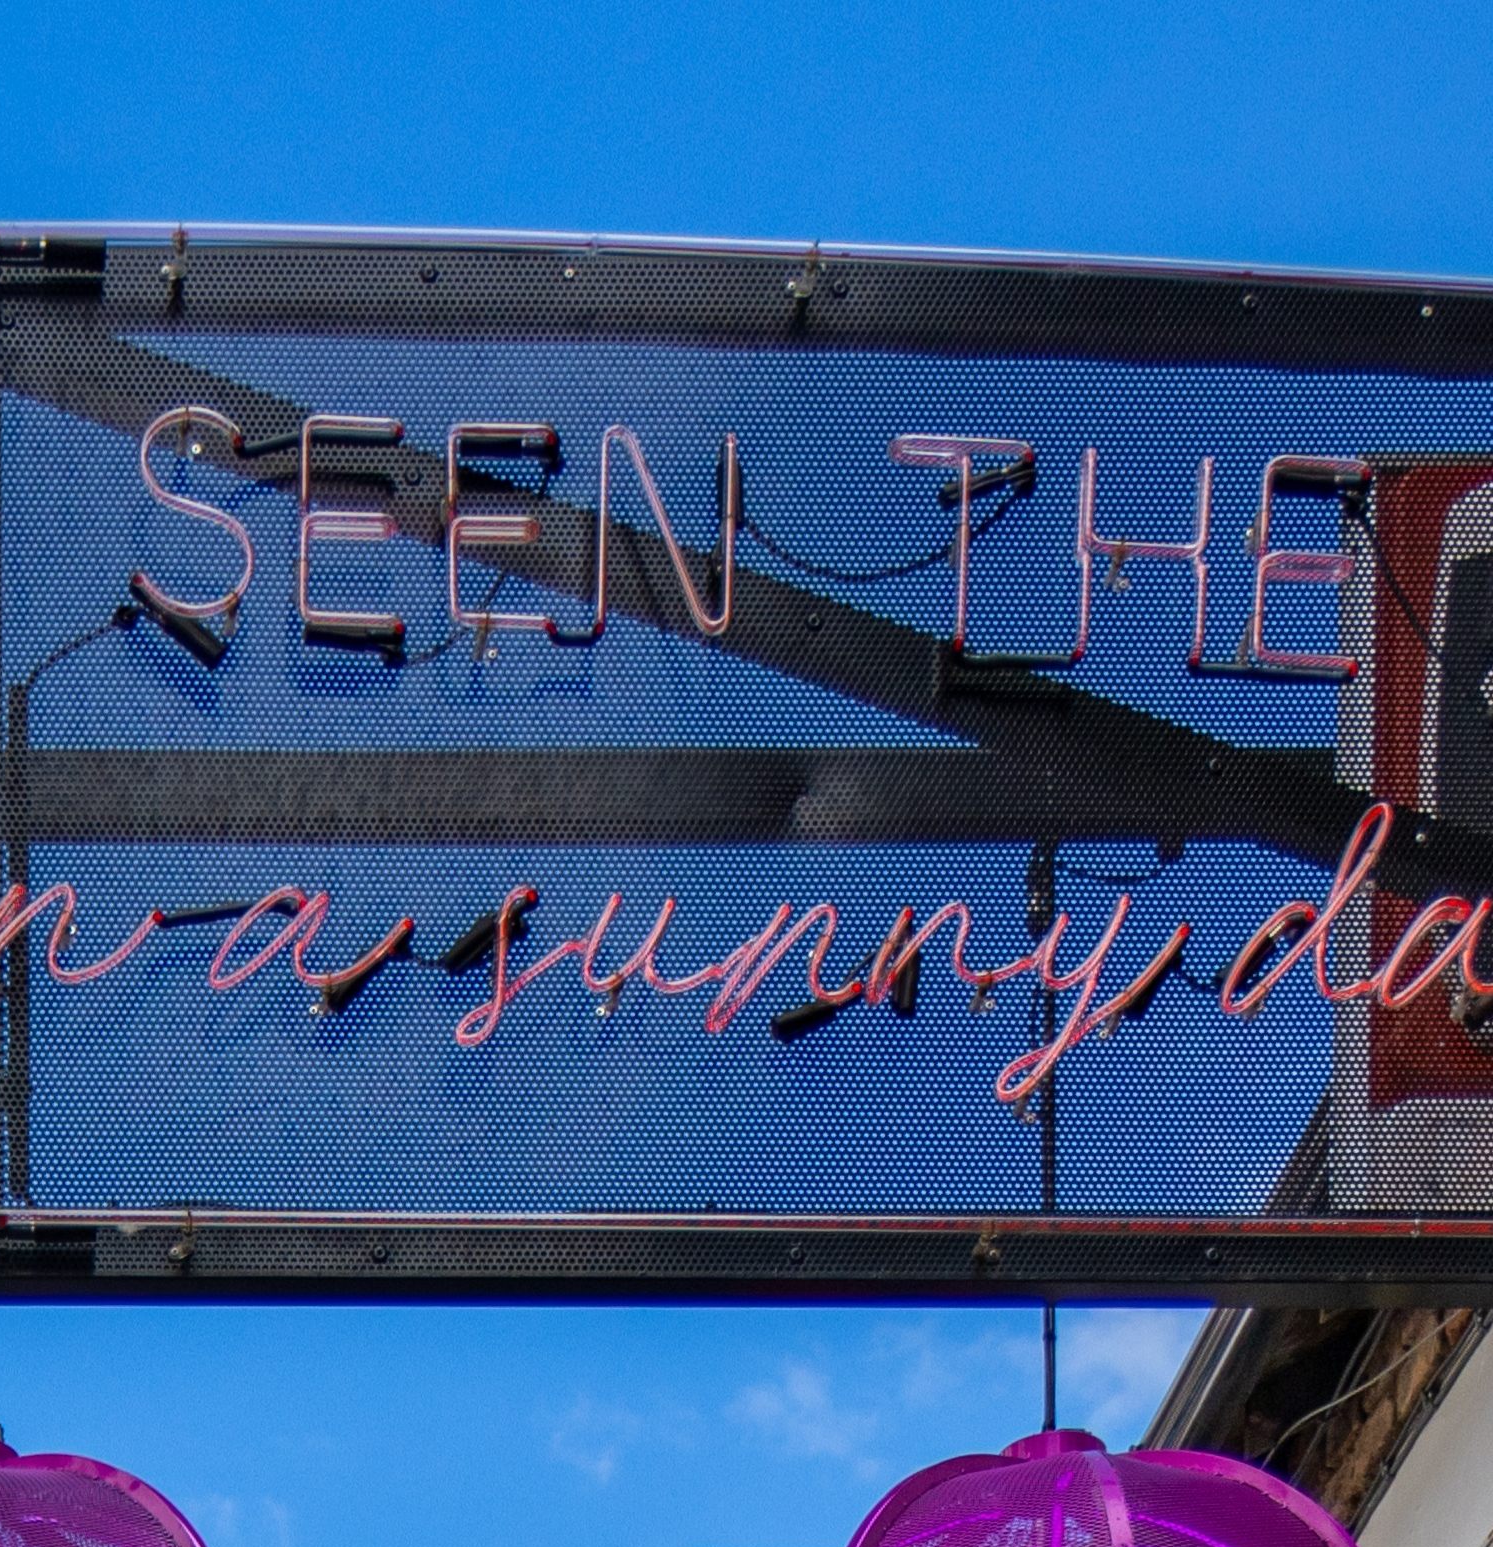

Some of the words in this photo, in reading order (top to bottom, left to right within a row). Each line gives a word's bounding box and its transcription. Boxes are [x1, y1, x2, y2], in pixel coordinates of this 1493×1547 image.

[131, 405, 737, 635] SEEN
[888, 433, 1373, 675] THE
[208, 885, 412, 993] a
[454, 885, 1191, 1103] sunny
